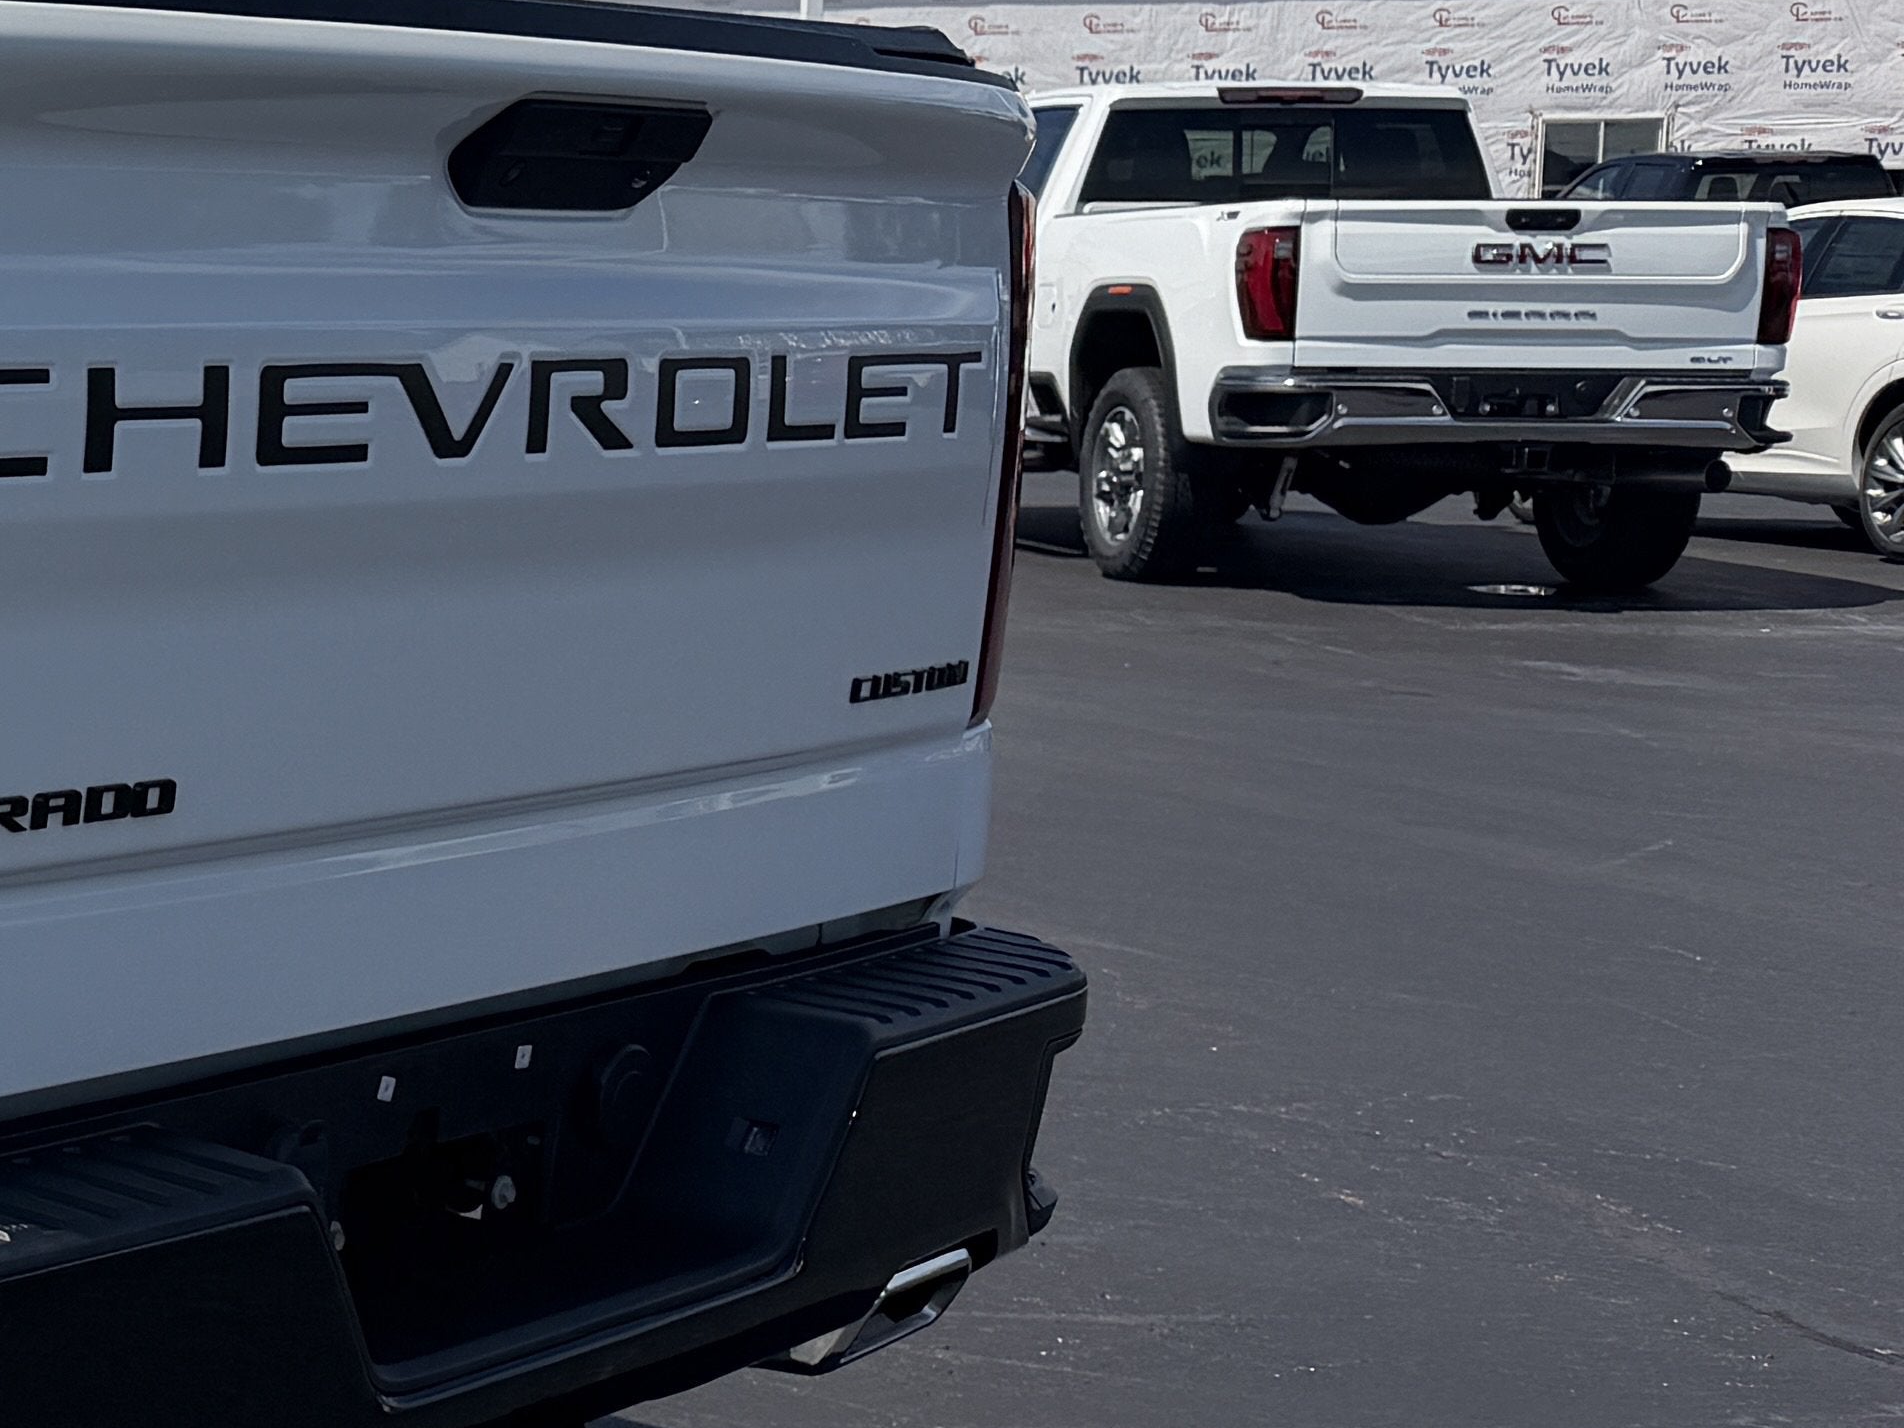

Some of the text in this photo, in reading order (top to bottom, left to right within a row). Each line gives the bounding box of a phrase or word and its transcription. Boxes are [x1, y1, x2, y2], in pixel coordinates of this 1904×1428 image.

[1425, 59, 1492, 84] Tyvek
[1543, 58, 1611, 81] Tyvek
[1662, 56, 1730, 79] Tyvek
[1781, 54, 1850, 78] Tyvek
[1864, 137, 1904, 161] Tyv
[1472, 243, 1612, 264] GMC
[849, 659, 969, 703] CUSTOM
